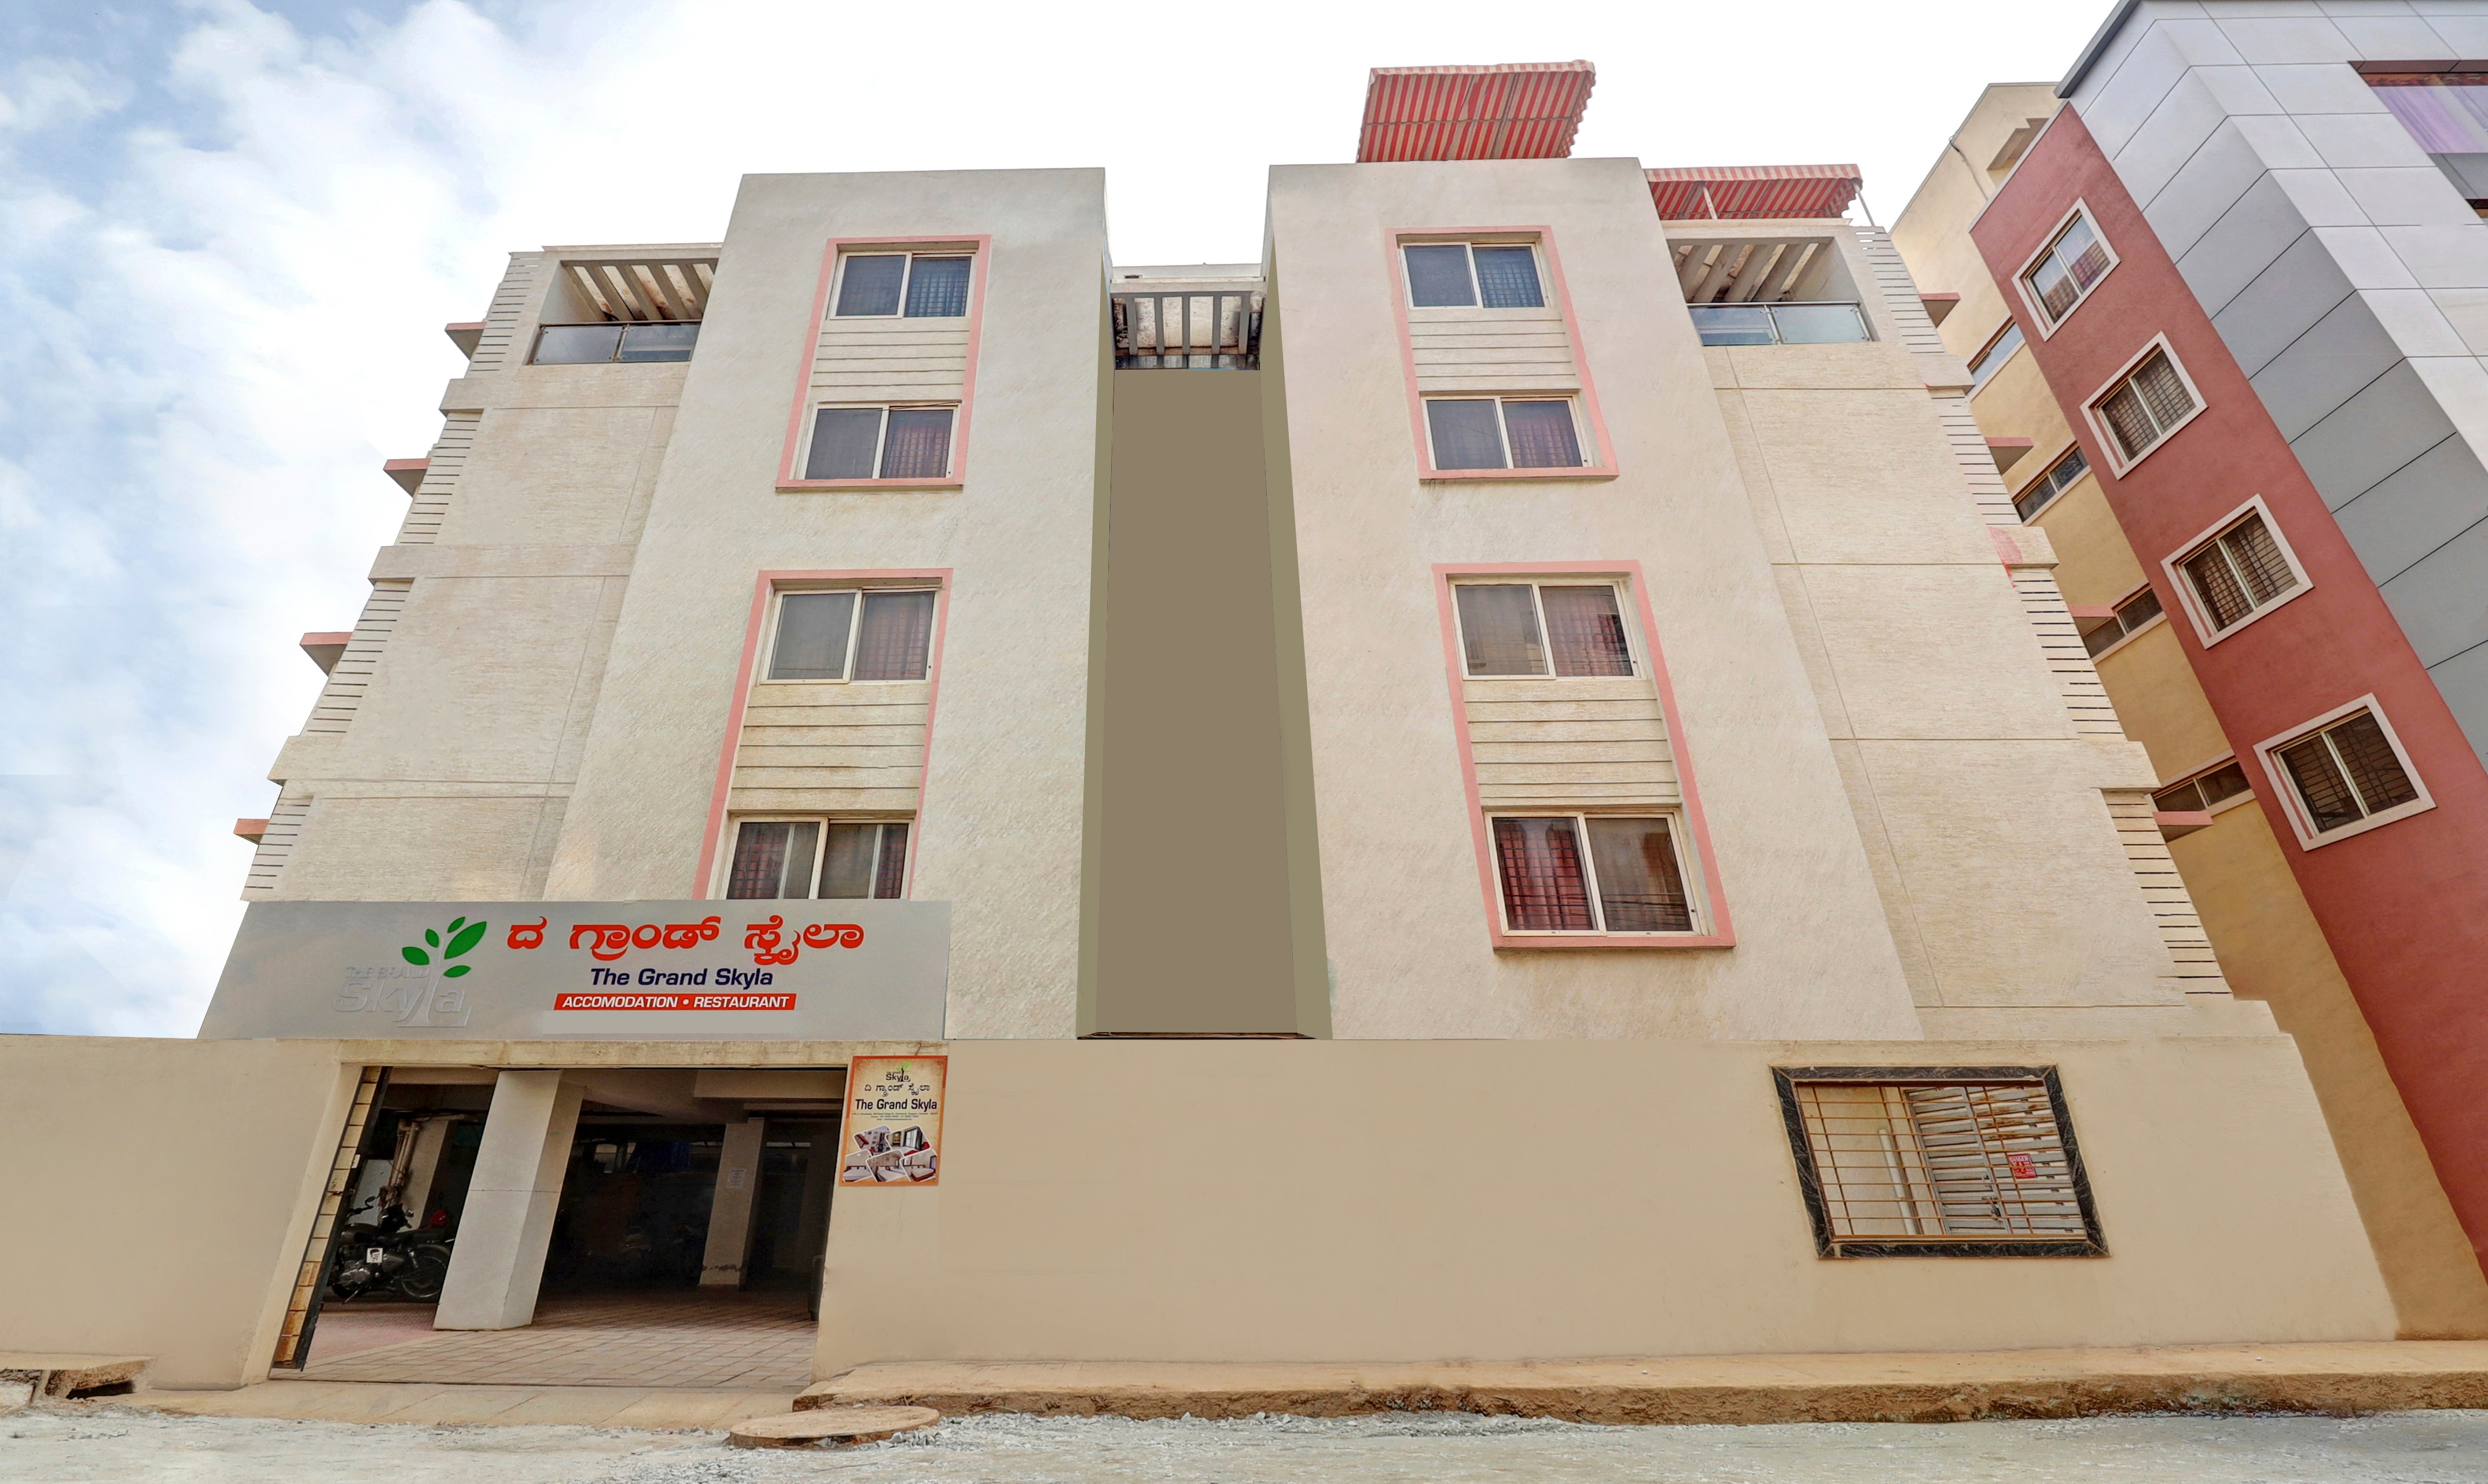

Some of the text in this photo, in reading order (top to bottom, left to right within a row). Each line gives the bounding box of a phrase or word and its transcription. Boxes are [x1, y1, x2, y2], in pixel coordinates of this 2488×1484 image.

[507, 916, 547, 949] ದ
[569, 916, 721, 961] ಗ್ರಾಂಡ್
[590, 968, 773, 990] The Grand Skyla
[562, 996, 790, 1008] ACCOMODATION RESTAURANT
[885, 1070, 910, 1082] Skyla
[855, 1099, 938, 1112] The Grand Skyla
